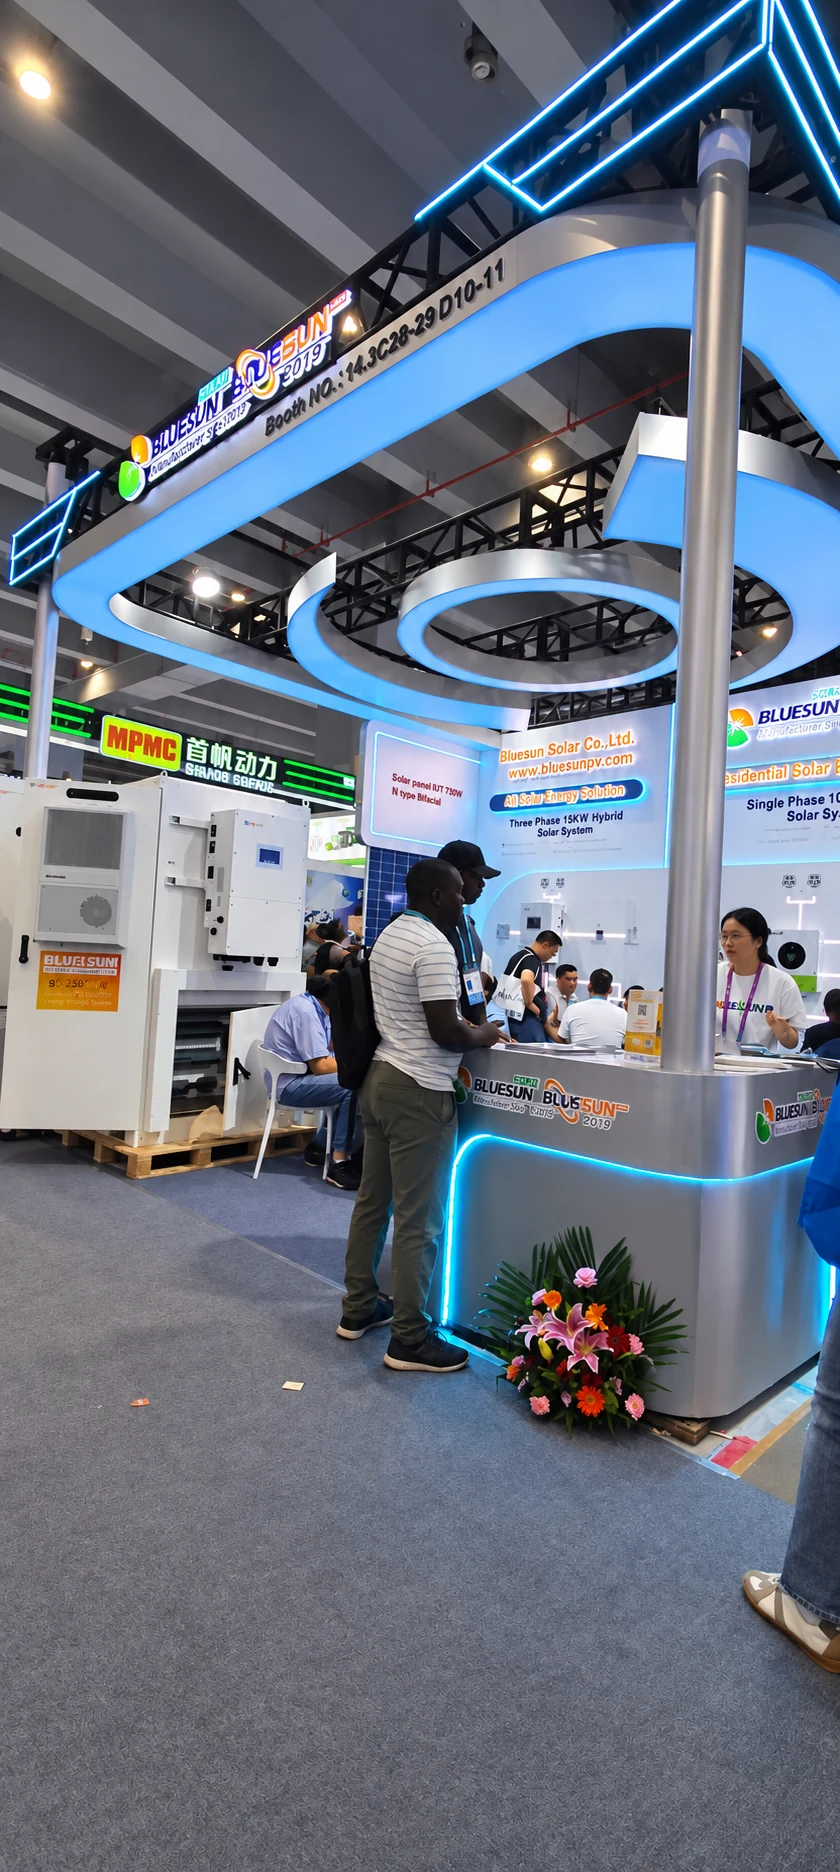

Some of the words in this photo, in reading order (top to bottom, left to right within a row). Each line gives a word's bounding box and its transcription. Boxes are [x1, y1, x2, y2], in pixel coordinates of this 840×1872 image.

[264, 397, 306, 437] Booth
[439, 257, 504, 321] D10-11
[758, 699, 840, 725] BLUESUN
[107, 724, 177, 762] MPMC
[500, 747, 544, 763] Bluesun
[548, 740, 580, 756] Solar
[584, 731, 635, 750] Co.,Ltd.
[186, 737, 278, 781] 首帆动力
[509, 753, 633, 779] www.bluesunpv.com
[392, 773, 411, 785] Solar
[412, 780, 431, 791] panel
[725, 765, 787, 785] esidential
[792, 761, 830, 778] Solar
[392, 787, 398, 796] N
[400, 789, 416, 800] type
[581, 785, 624, 799] Solution
[747, 798, 784, 811] Single
[788, 795, 825, 807] Phase
[509, 819, 533, 828] Three
[535, 817, 560, 826] Phase
[563, 814, 588, 824] 15KW
[592, 810, 624, 824] Hybrid
[787, 809, 819, 822] Solar
[823, 808, 840, 821] Sy
[537, 828, 559, 838] Solar
[561, 826, 593, 838] System
[474, 1078, 533, 1101] BLUESUN
[583, 1115, 611, 1129] 2019
